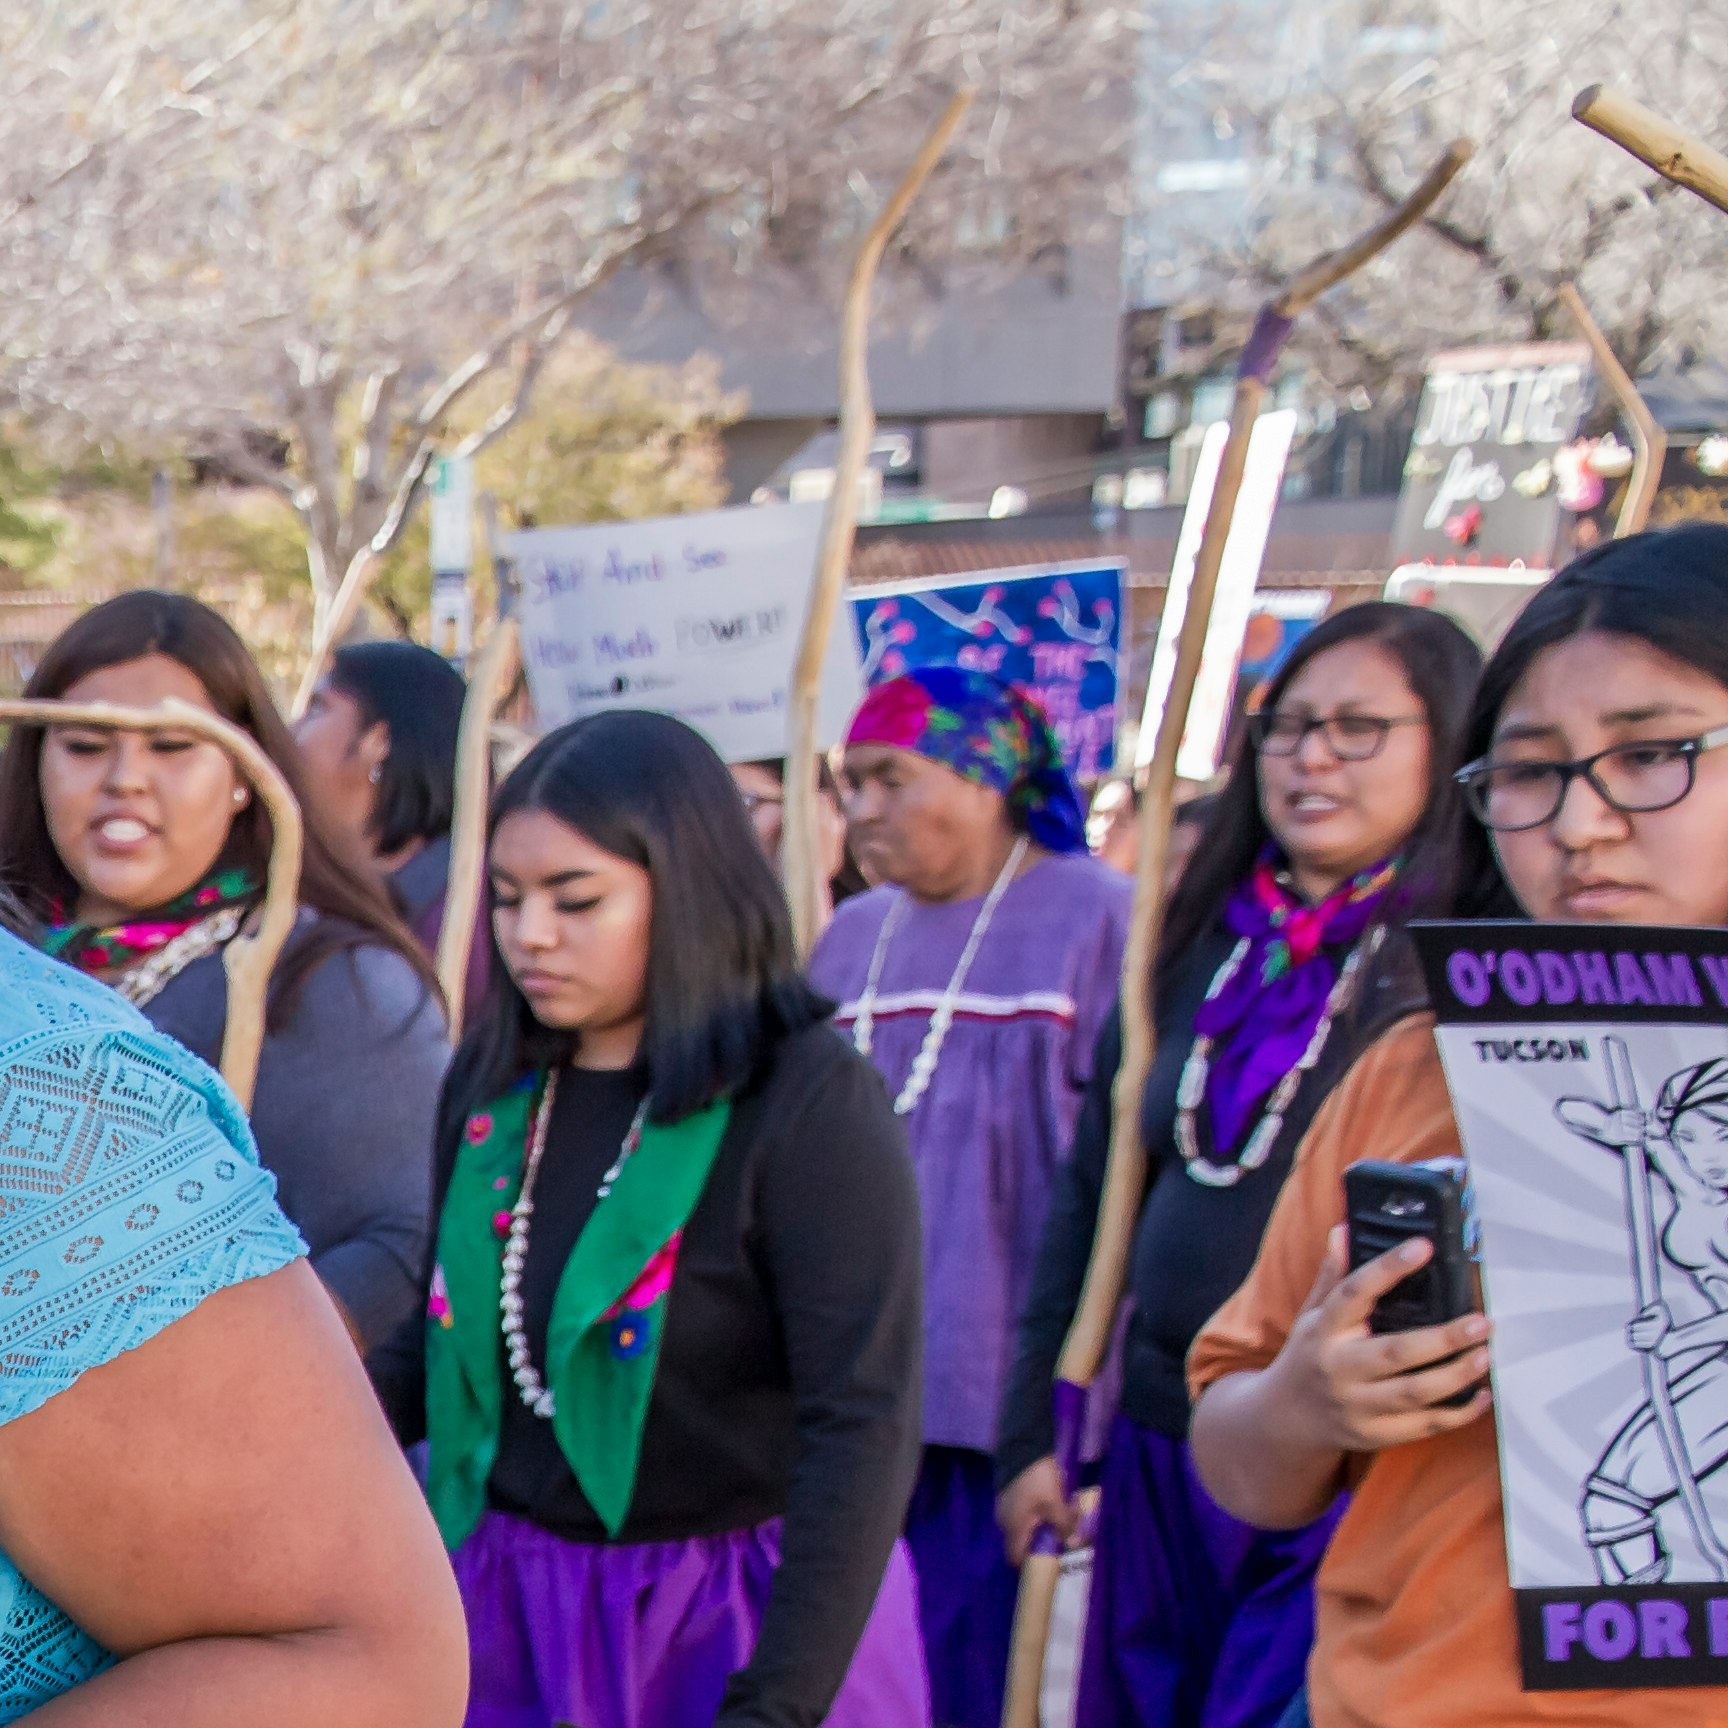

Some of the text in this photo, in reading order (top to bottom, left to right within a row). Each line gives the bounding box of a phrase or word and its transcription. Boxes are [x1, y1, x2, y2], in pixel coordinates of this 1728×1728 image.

[1446, 949, 1704, 1007] O'ODHAM
[1473, 1038, 1590, 1062] TUCSON
[1542, 1599, 1694, 1662] FOR
